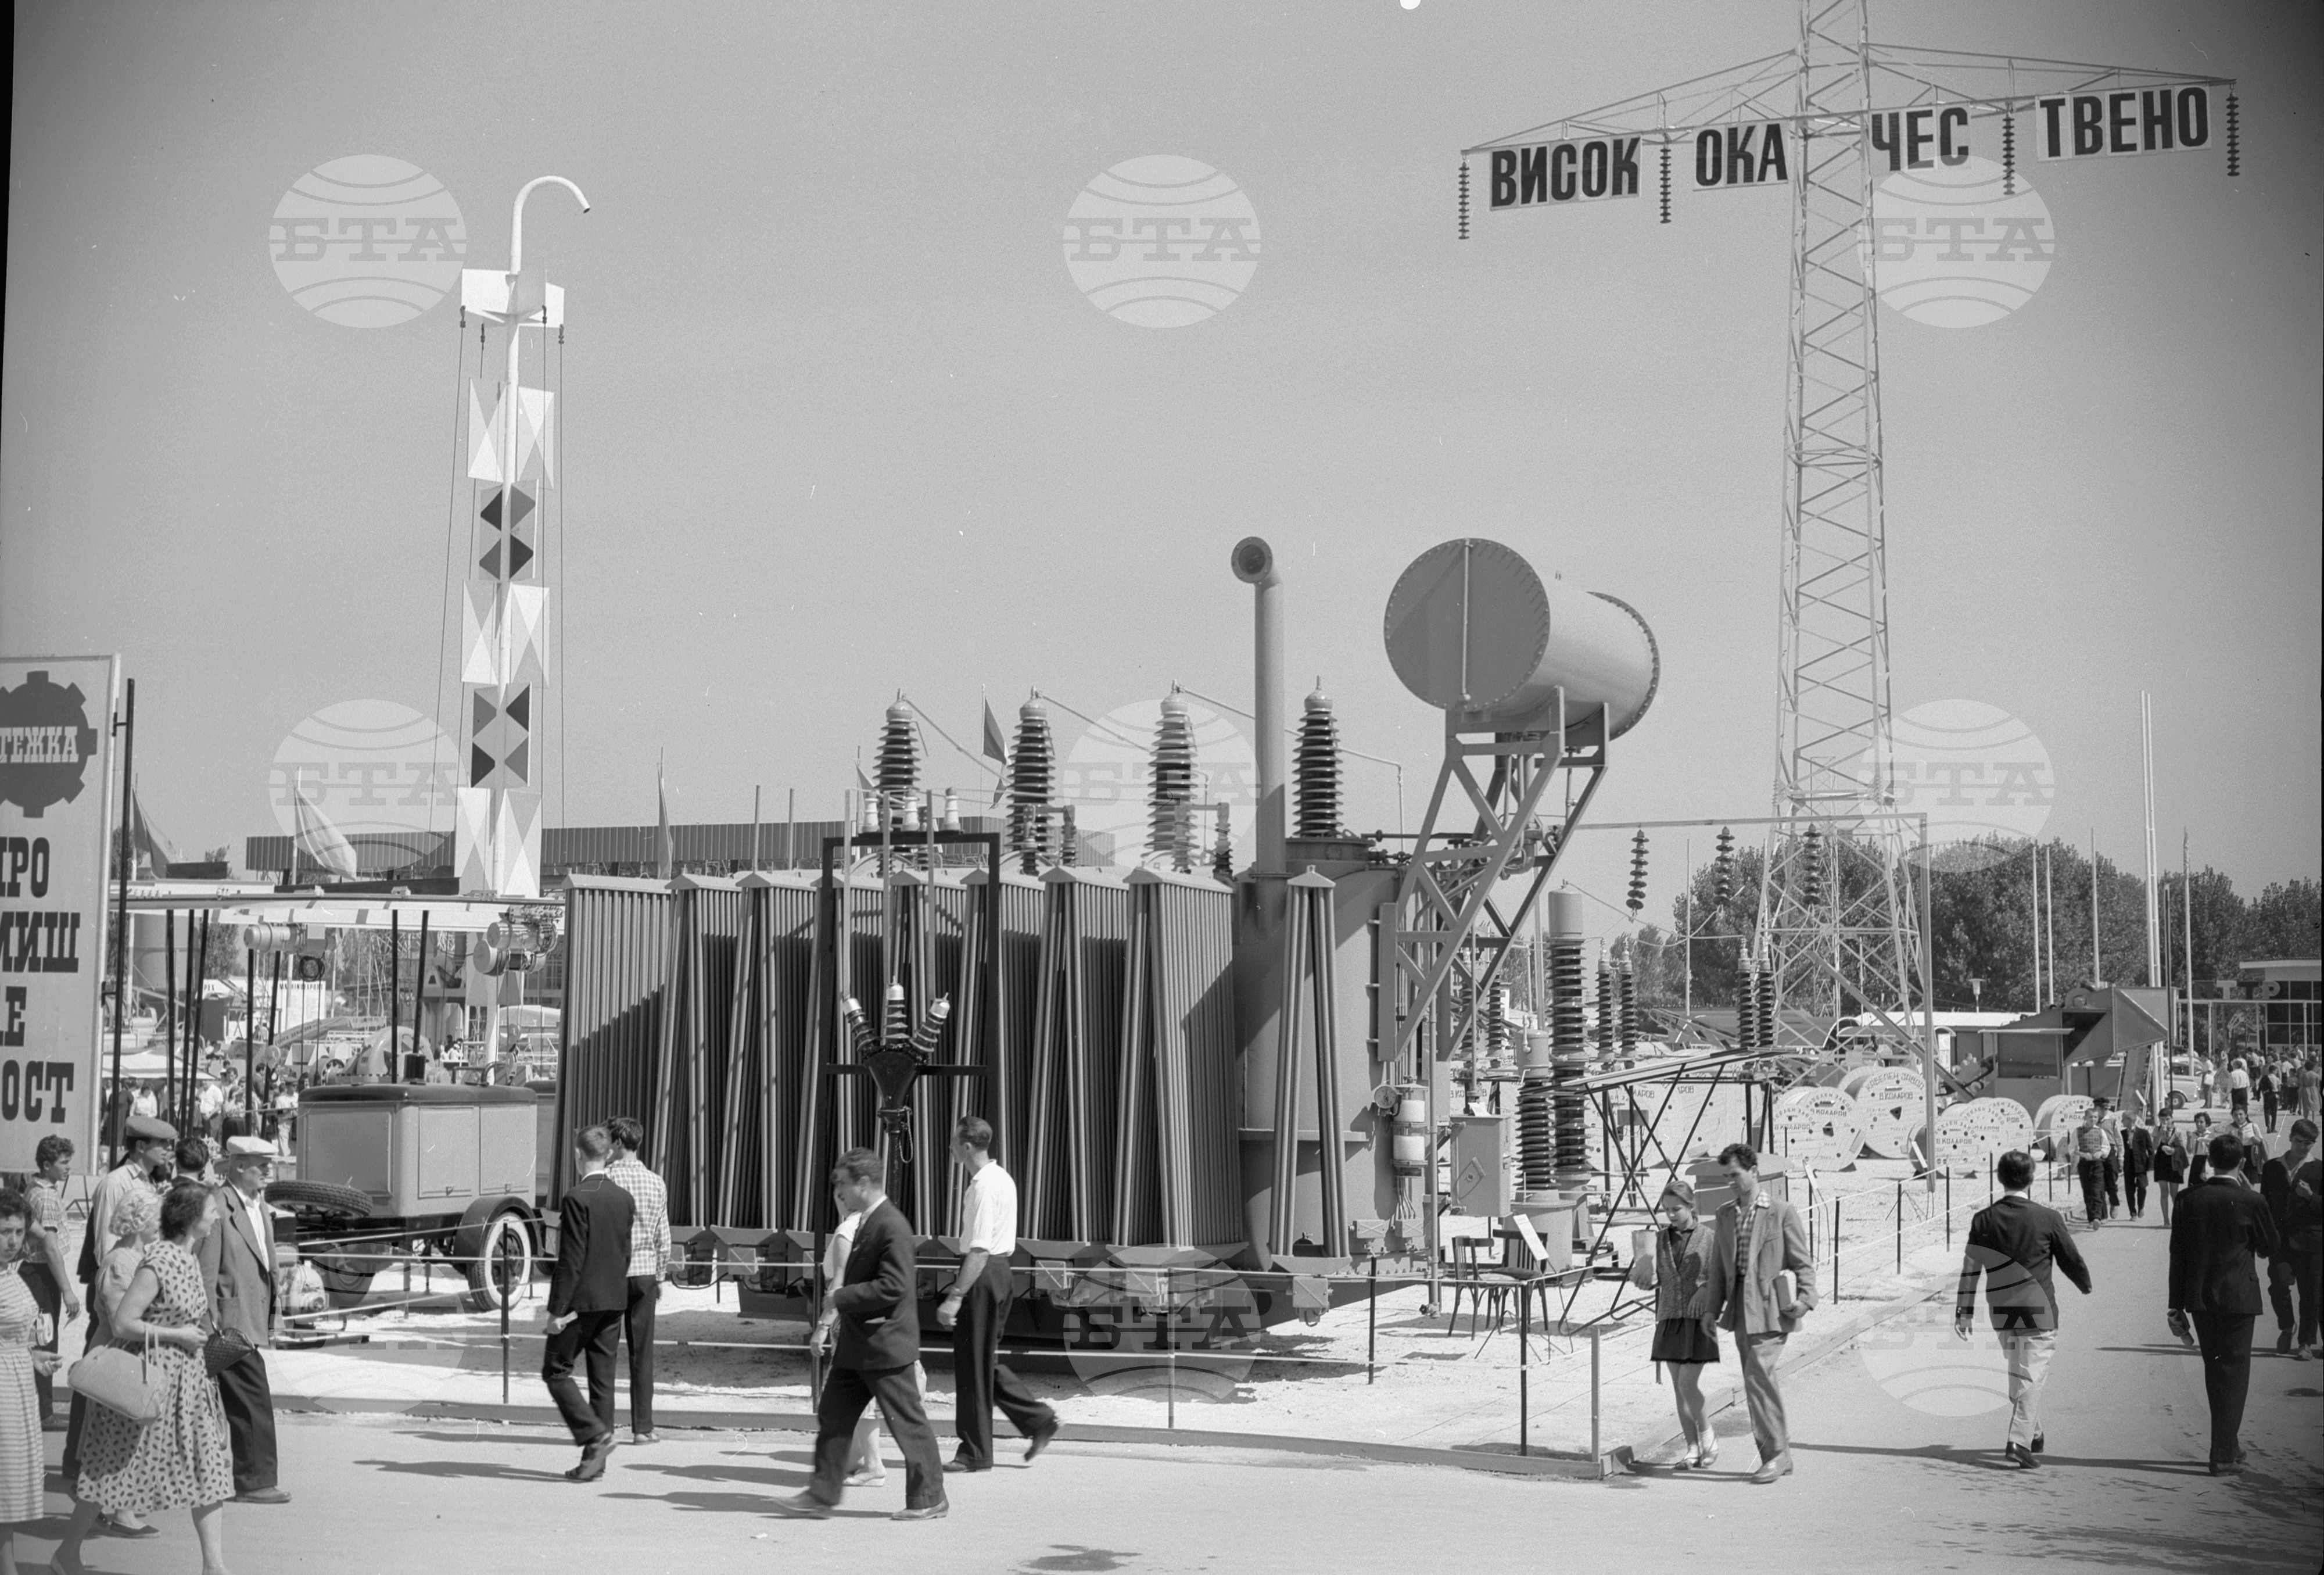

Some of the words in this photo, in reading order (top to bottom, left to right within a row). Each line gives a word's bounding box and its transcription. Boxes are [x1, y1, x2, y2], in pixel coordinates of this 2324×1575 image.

[1491, 137, 1640, 207] ВИСОК
[1696, 123, 1788, 186] ОКА
[1871, 107, 1969, 171] ЧЕС
[2040, 87, 2208, 158] ТВЕНО
[0, 726, 79, 763] ТЕЖКА
[2, 1059, 74, 1123] ОСТ
[1901, 1073, 1925, 1090] ЗАВОД
